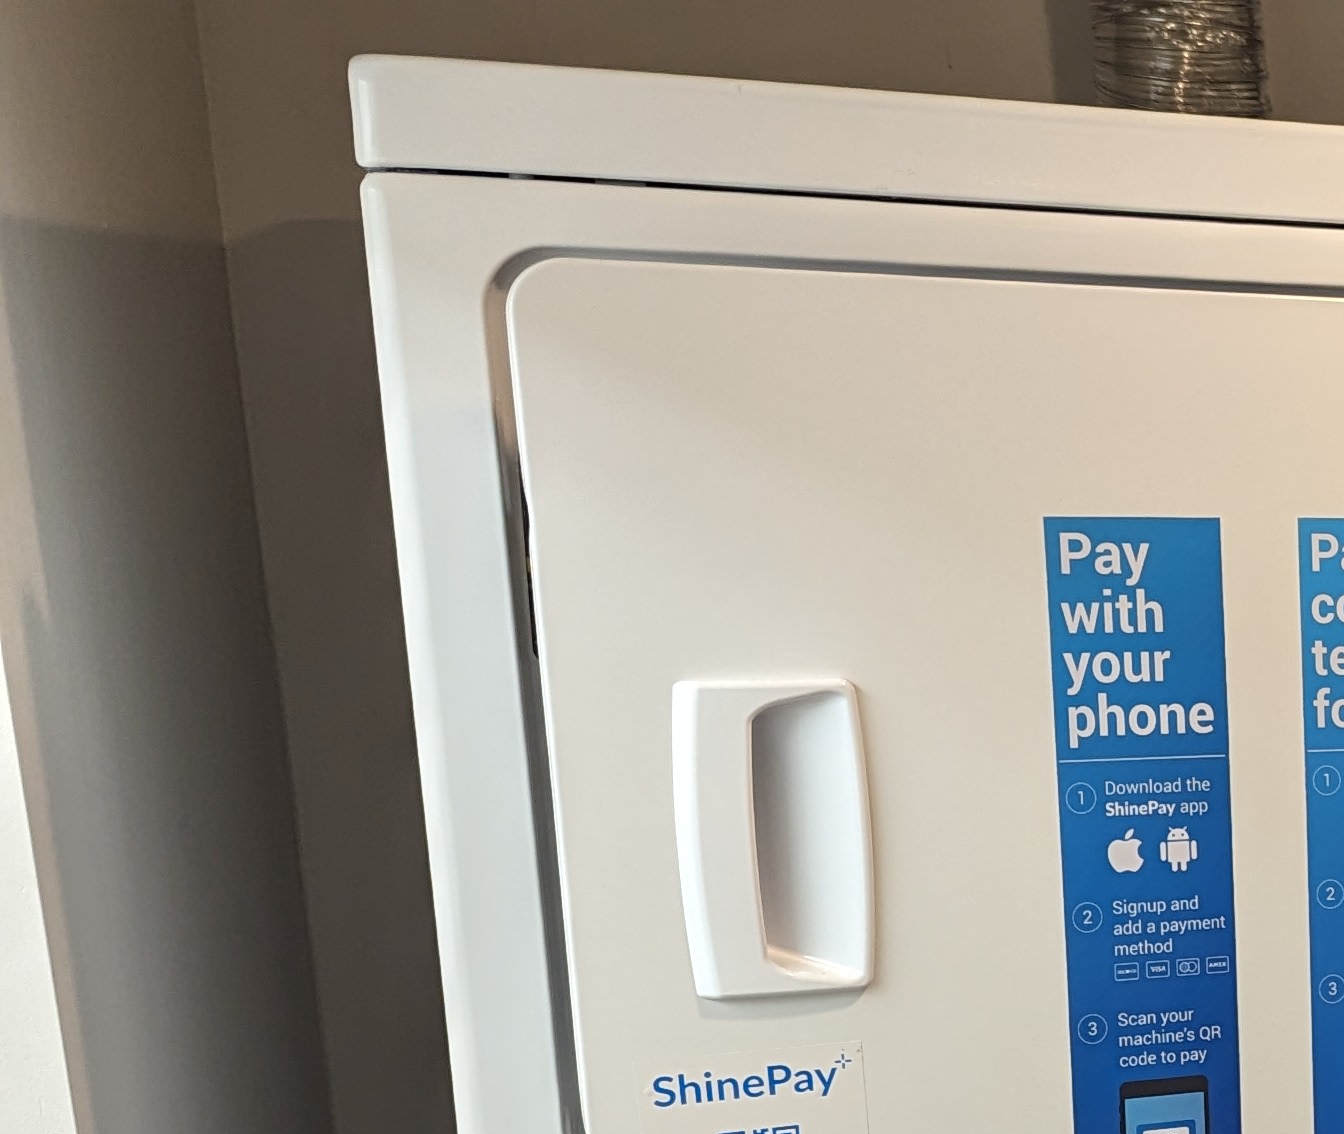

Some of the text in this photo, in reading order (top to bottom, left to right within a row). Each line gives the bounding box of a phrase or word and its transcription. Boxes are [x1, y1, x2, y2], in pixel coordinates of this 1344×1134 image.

[1059, 531, 1150, 586] Pay
[1061, 589, 1164, 634] with
[1063, 648, 1170, 696] your
[1067, 693, 1215, 749] phone
[1078, 776, 1211, 805] 1 Download the
[1324, 773, 1331, 787] 1
[1105, 800, 1208, 818] ShinePay app
[1326, 887, 1335, 900] 2
[1082, 895, 1199, 925] 2 Signup and
[1113, 914, 1226, 935] add a payment
[1114, 938, 1173, 956] method
[1328, 982, 1337, 996] 3
[1088, 1008, 1194, 1036] 3 Scan your
[1118, 1026, 1222, 1048] machine's QR
[1119, 1049, 1207, 1068] code to pay
[653, 1064, 837, 1107] ShinePay
